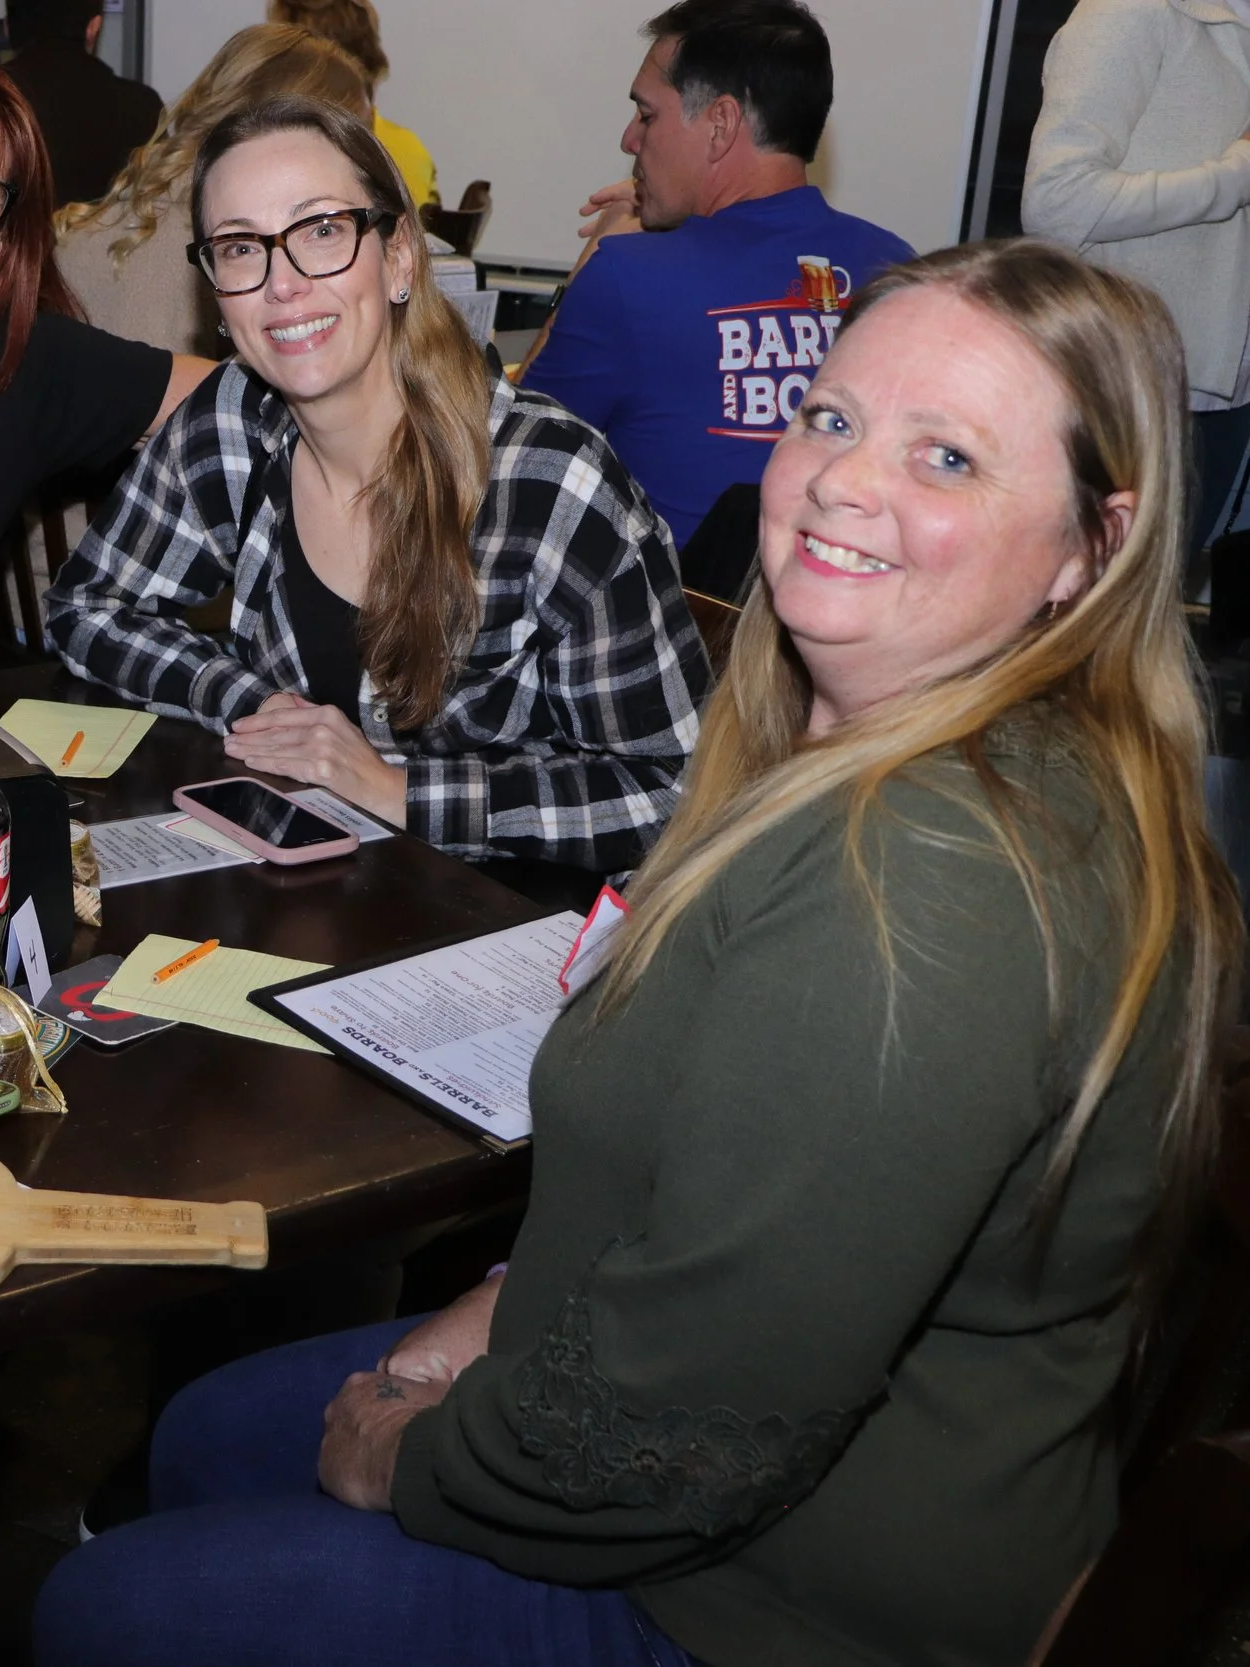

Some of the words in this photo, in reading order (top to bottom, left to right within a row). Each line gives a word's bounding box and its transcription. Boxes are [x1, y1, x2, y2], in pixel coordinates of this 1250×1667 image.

[723, 374, 736, 420] AND
[342, 1025, 410, 1068] BOARDS
[419, 1072, 500, 1119] BARRELS
